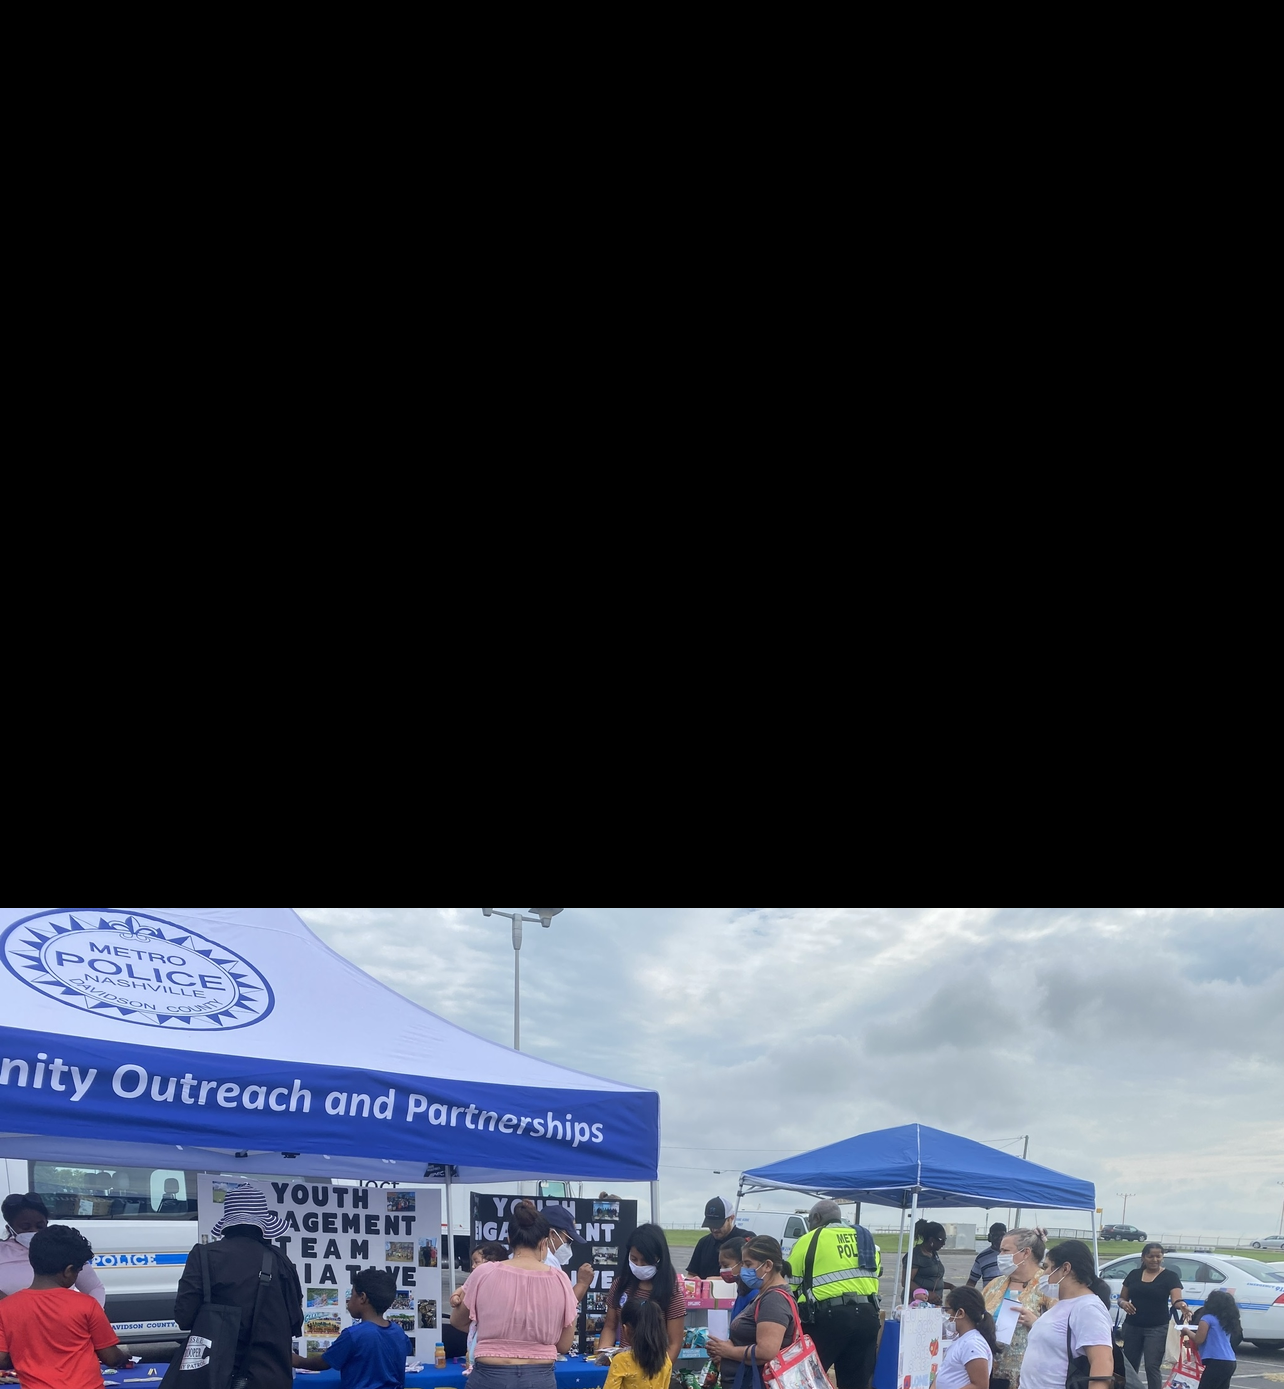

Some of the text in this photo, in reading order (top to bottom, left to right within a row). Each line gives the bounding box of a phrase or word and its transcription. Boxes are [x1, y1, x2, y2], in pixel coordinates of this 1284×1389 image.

[88, 941, 187, 967] METRO
[55, 950, 227, 992] POLICE
[68, 977, 224, 1014] DAVIDSON COUNTY
[84, 973, 207, 999] NASHVILLE
[0, 1053, 604, 1147] nity Outreach and Partnerships
[271, 1182, 369, 1210] YOUTH
[92, 1254, 156, 1267] POLICE
[275, 1236, 369, 1260] TEAM
